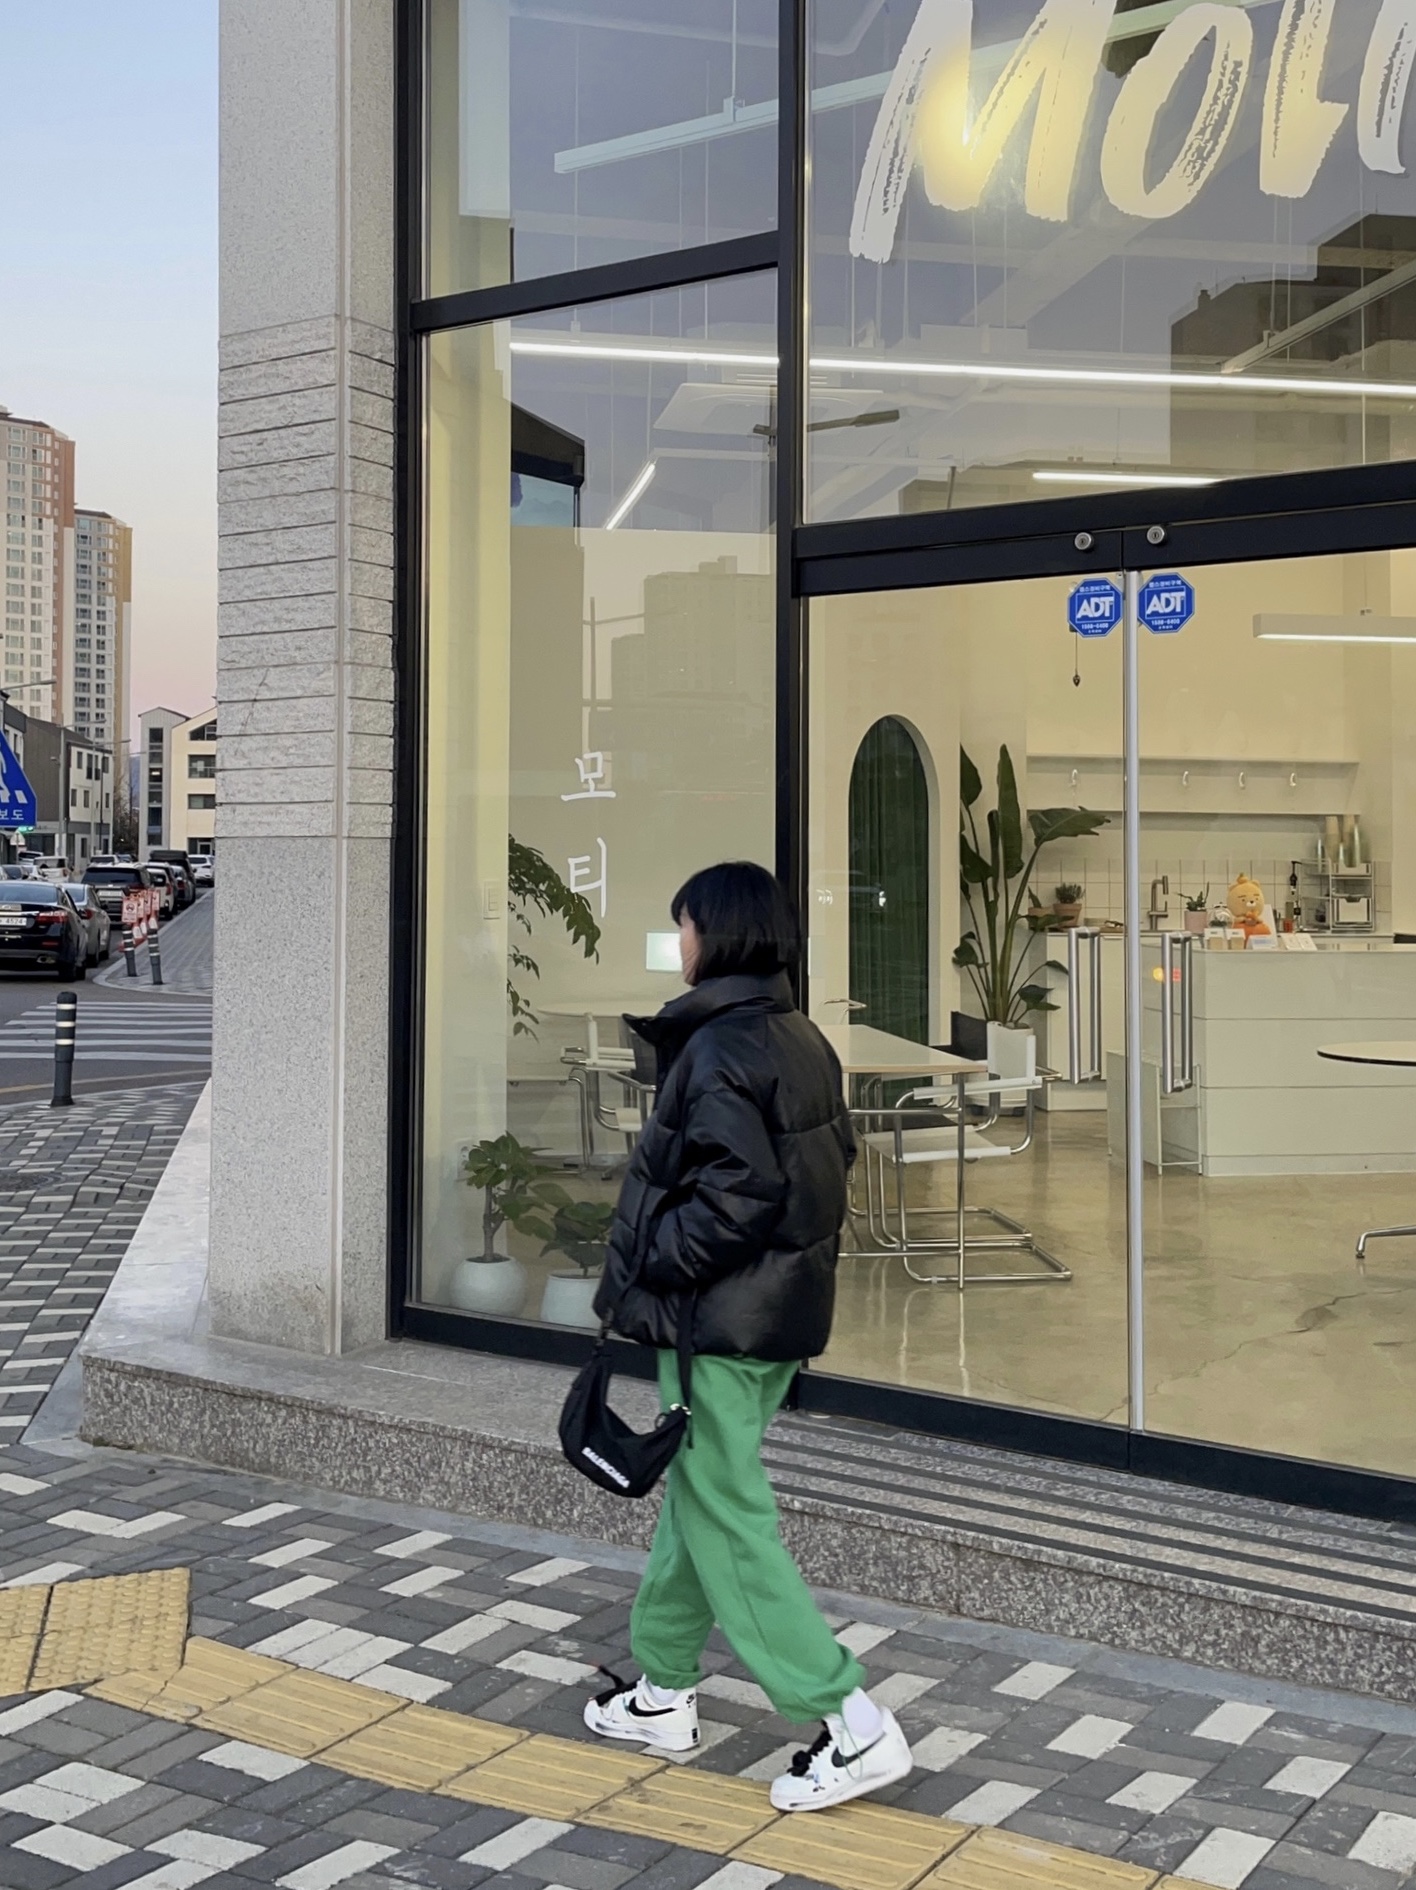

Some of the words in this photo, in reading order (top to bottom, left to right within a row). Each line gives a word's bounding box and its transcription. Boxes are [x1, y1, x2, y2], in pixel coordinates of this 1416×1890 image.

[1076, 597, 1114, 618] ADT
[1146, 592, 1185, 614] ADT
[561, 752, 616, 918] 모티
